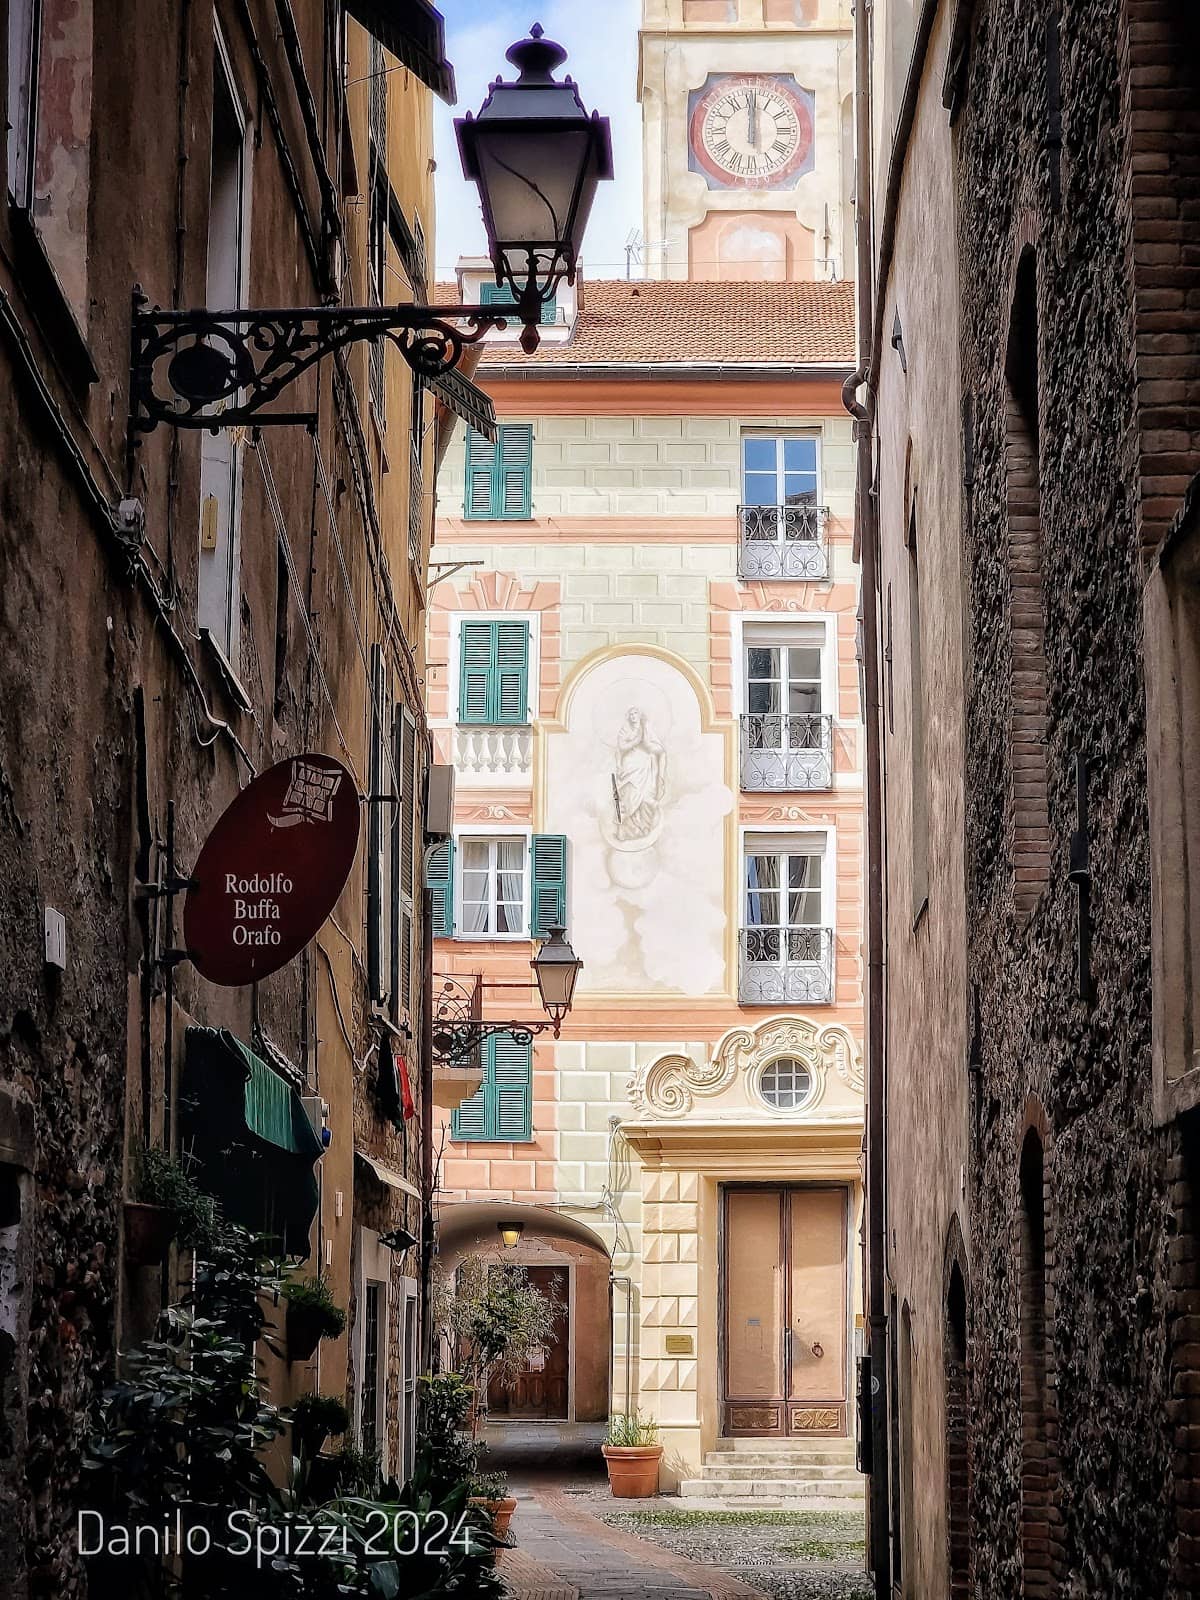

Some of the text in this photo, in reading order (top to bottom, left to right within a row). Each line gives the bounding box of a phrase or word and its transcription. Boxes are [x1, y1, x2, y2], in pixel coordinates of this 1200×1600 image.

[225, 873, 293, 894] Rodolfo
[234, 899, 281, 920] Buffa
[232, 925, 281, 946] Orafo
